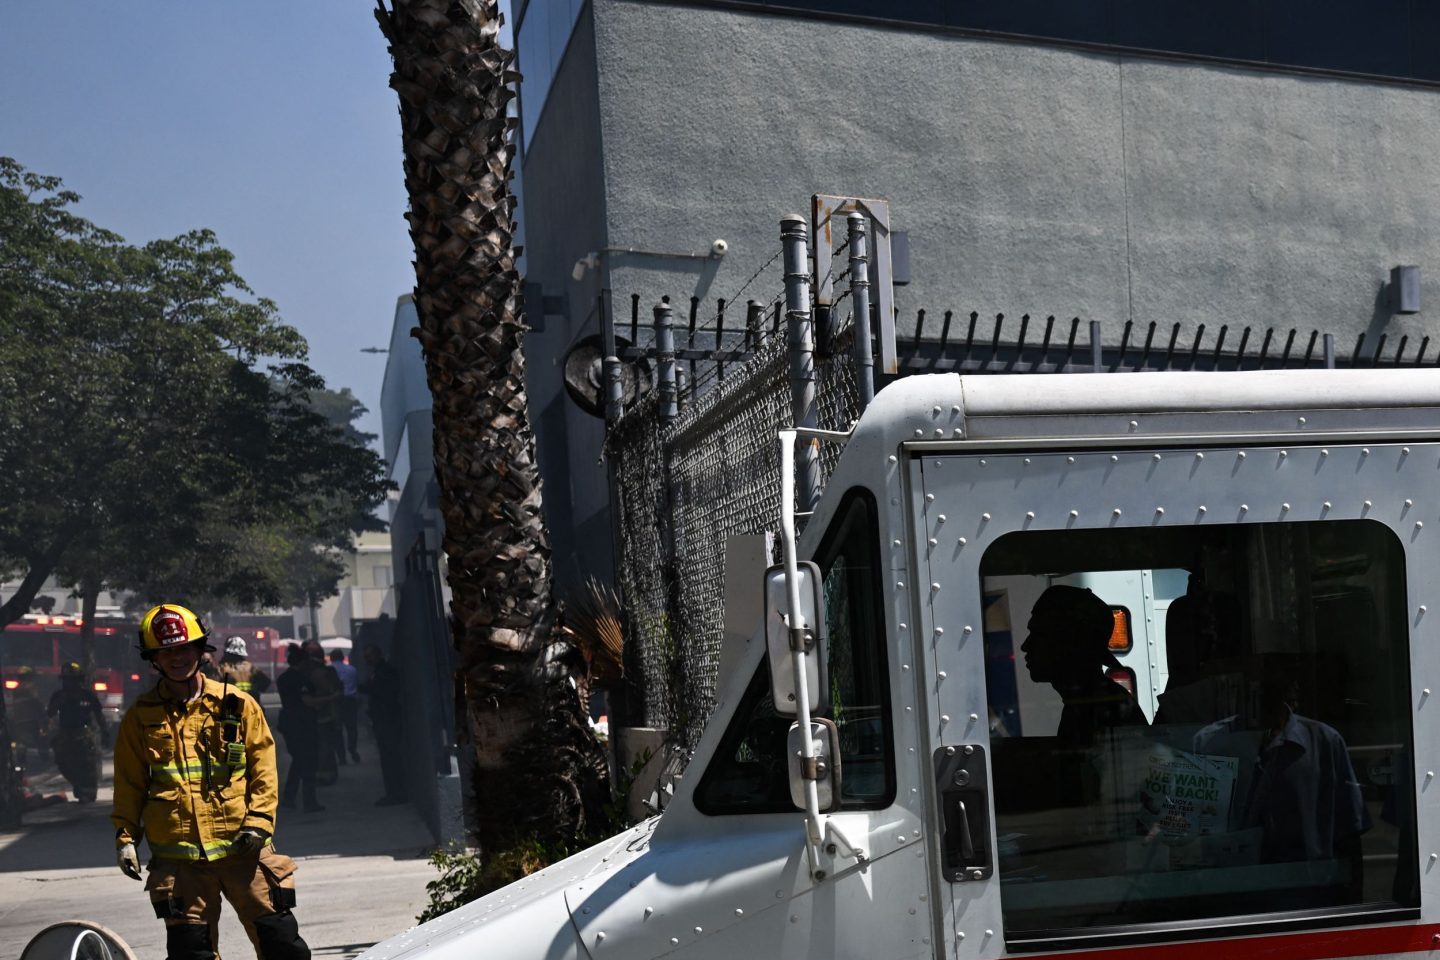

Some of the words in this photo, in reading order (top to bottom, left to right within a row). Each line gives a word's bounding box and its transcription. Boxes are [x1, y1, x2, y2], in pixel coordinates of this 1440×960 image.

[1145, 777, 1171, 796] YOU
[1175, 786, 1219, 802] BACK!
[1149, 767, 1171, 783] WE
[1174, 773, 1218, 789] WANT
